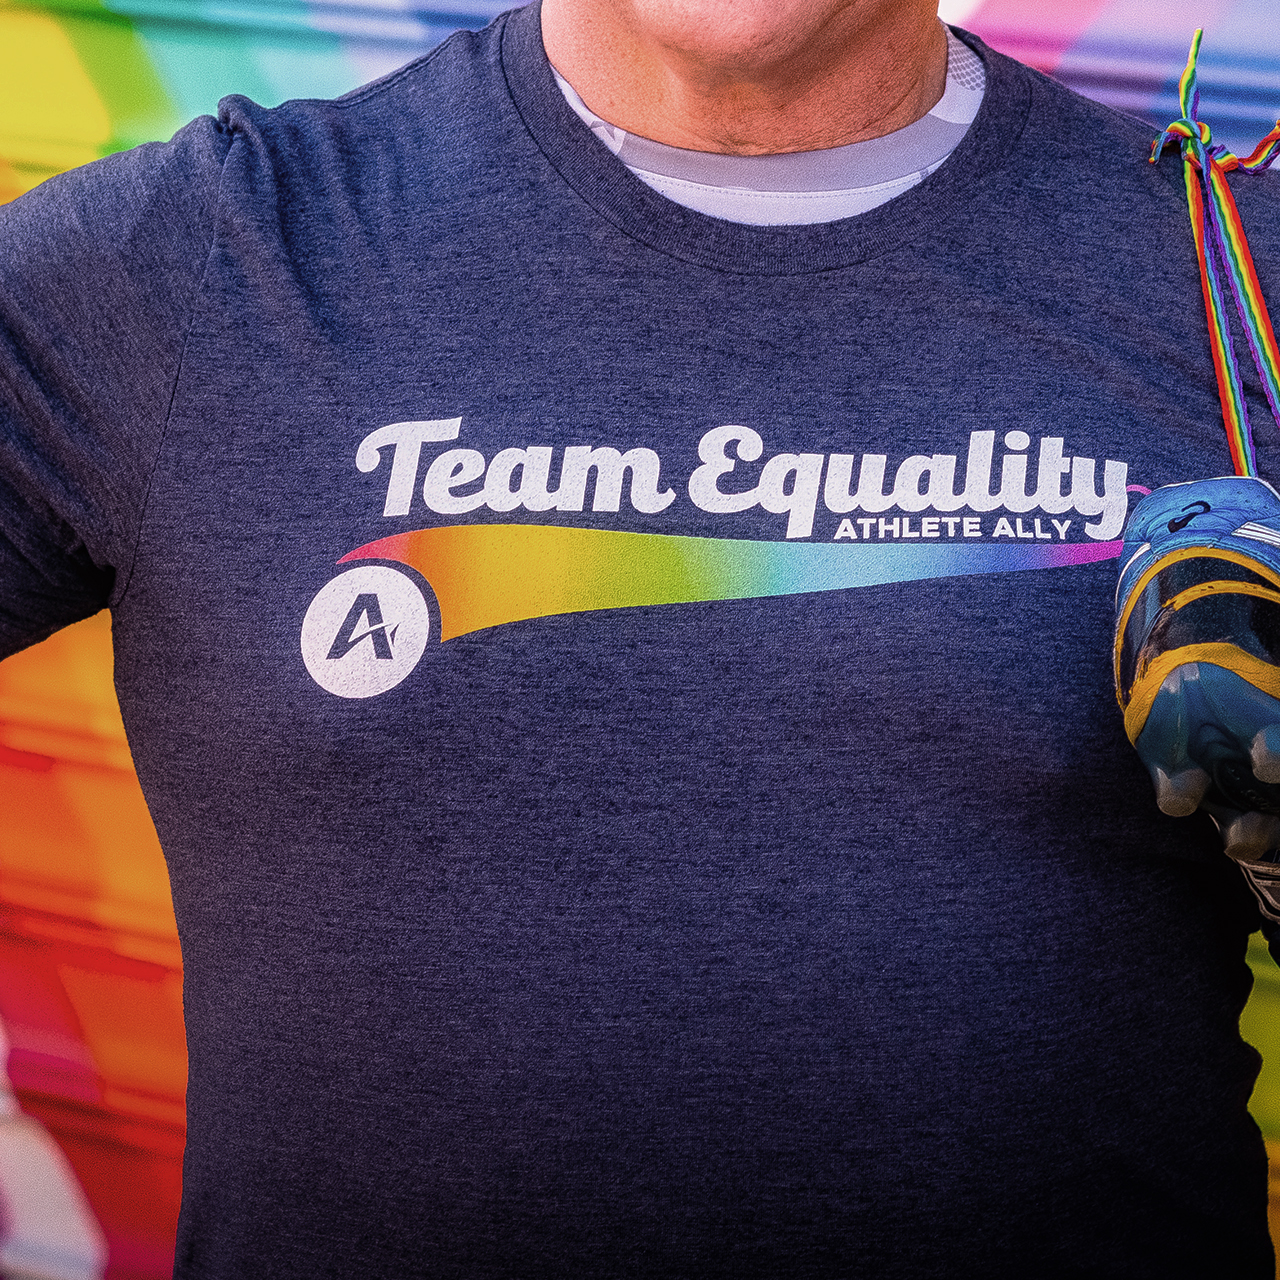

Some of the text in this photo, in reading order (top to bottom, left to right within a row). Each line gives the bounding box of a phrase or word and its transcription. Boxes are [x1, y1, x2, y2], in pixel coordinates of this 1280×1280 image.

[355, 416, 1129, 541] Team Equality
[833, 516, 1072, 540] ATHLETE ALLY
